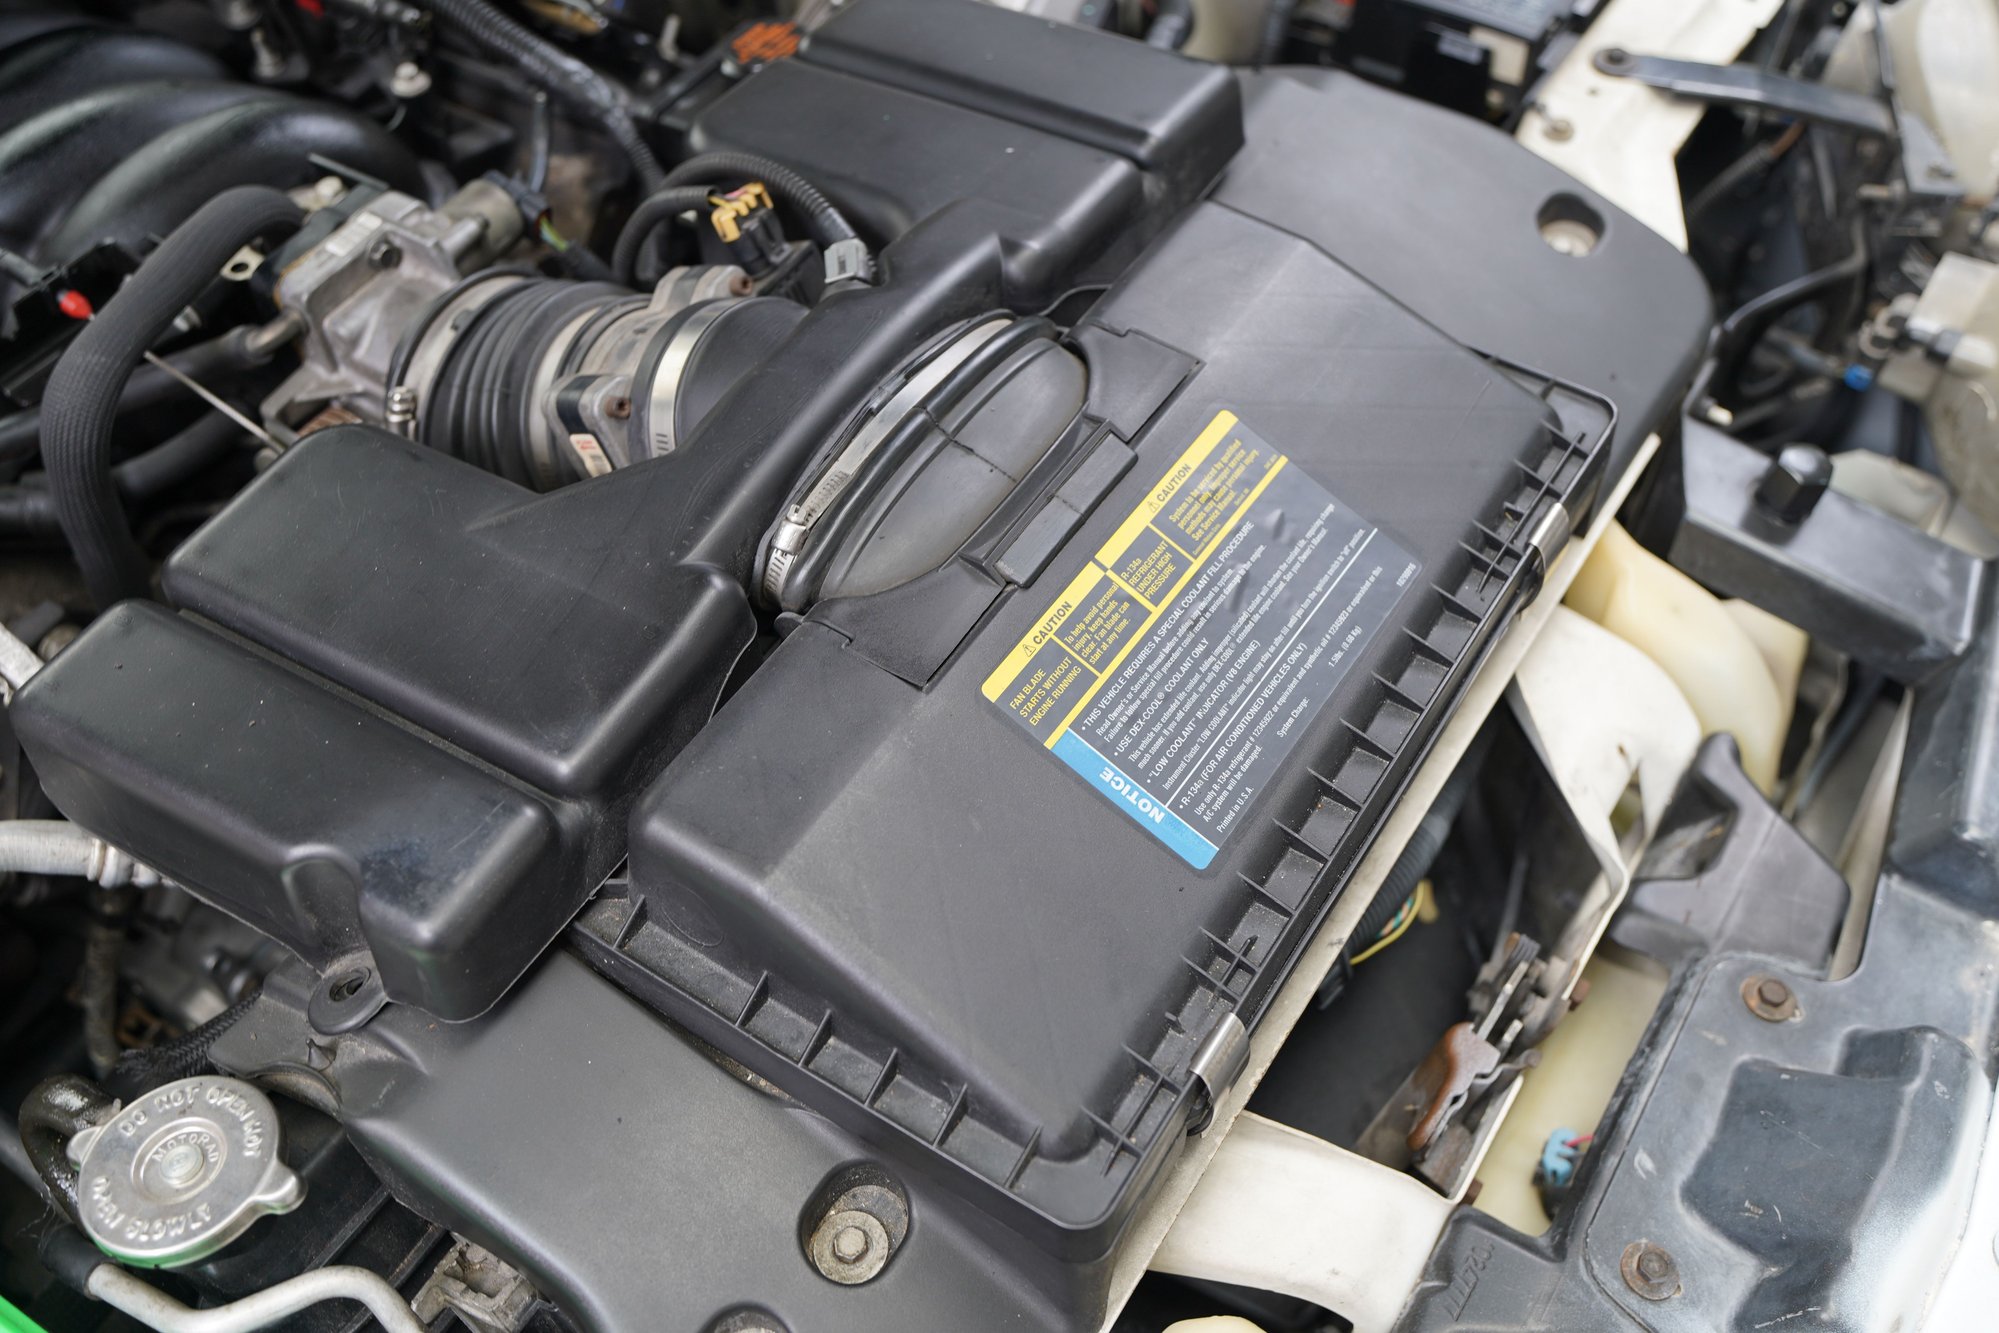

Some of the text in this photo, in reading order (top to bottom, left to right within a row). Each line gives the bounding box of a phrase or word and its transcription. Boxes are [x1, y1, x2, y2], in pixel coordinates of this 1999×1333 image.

[1156, 463, 1192, 502] CAUTION
[1120, 557, 1142, 580] R-134a
[1128, 539, 1168, 586] REFRIGERANT
[1135, 551, 1172, 592] UNDER HIGH
[1143, 561, 1176, 599] PRESSURE
[1032, 600, 1072, 644] CAUTION
[1063, 581, 1119, 644] To help avoid personal
[1071, 599, 1118, 651] injury, keep hands
[1081, 601, 1130, 658] clear. Fan blade can
[1082, 707, 1101, 726] THIS
[1097, 676, 1127, 709] VEHICLE
[1122, 641, 1156, 679] REQUIRES
[1152, 635, 1161, 644] A
[1157, 607, 1185, 637] SPECIAL
[1180, 573, 1210, 608] COOLANT
[1206, 561, 1223, 576] FILL
[1218, 520, 1254, 562] PROCEDURE
[1088, 615, 1131, 664] start at any time.
[1095, 568, 1235, 736] Read Owner's or Service Manual before adding any coolant to system.
[1103, 566, 1246, 742] Failure to follow special fill procedure could result in serious damage to
[1127, 593, 1263, 762] This vehicle has extended life coolant. Adding improper (silicated) coolant
[1137, 752, 1152, 769] much
[1148, 735, 1166, 755] sooner.
[1161, 728, 1170, 736] If
[1166, 720, 1177, 732] you
[1174, 709, 1185, 722] add
[1181, 691, 1201, 712] coolant,
[1197, 681, 1207, 693] use
[1204, 670, 1216, 683] only
[1235, 620, 1255, 644] extended
[1250, 612, 1261, 623] life
[1258, 597, 1273, 615] engine
[1269, 580, 1287, 599] coolant.
[1195, 679, 1229, 719] INDICATOR
[1225, 667, 1237, 682] (V8
[1233, 639, 1261, 669] ENGINE)
[1009, 667, 1046, 709] FAN BLADE
[1019, 655, 1072, 717] STARTS WITHOUT
[1028, 665, 1081, 726] ENGINE RUNNING
[1115, 734, 1132, 752] USE
[1163, 655, 1194, 692] COOLANT
[1191, 637, 1208, 658] ONLY
[1161, 760, 1187, 790] Instrument
[1182, 743, 1200, 763] Cluster
[1226, 682, 1246, 706] indicator
[1242, 670, 1255, 685] light
[1252, 661, 1264, 674] may
[1260, 651, 1272, 663] stay
[1268, 644, 1276, 653] on
[1273, 633, 1284, 647] after
[1180, 642, 1307, 805] R-134a (FOR AIR CONDITIONED VEHICLES ONLY)
[1193, 802, 1206, 815] Use
[1203, 789, 1217, 803] only
[1211, 769, 1231, 791] R-134a
[1228, 740, 1252, 771] refrigerant
[1251, 710, 1275, 737] 12345922
[1271, 704, 1279, 712] or
[1276, 677, 1299, 706] equivalent
[1296, 666, 1306, 680] and
[1303, 645, 1323, 669] synthetic
[1320, 637, 1328, 647] oil
[1276, 696, 1310, 737] System Charge:
[1099, 766, 1165, 824] NOTICE
[1202, 744, 1263, 822] A/C system will be damaged.
[1216, 786, 1254, 833] Printed in U.S.A.
[118, 1111, 148, 1137] DO
[153, 1086, 200, 1113] NOT
[206, 1087, 254, 1123] OPEN
[151, 1132, 219, 1163] MOTORAD
